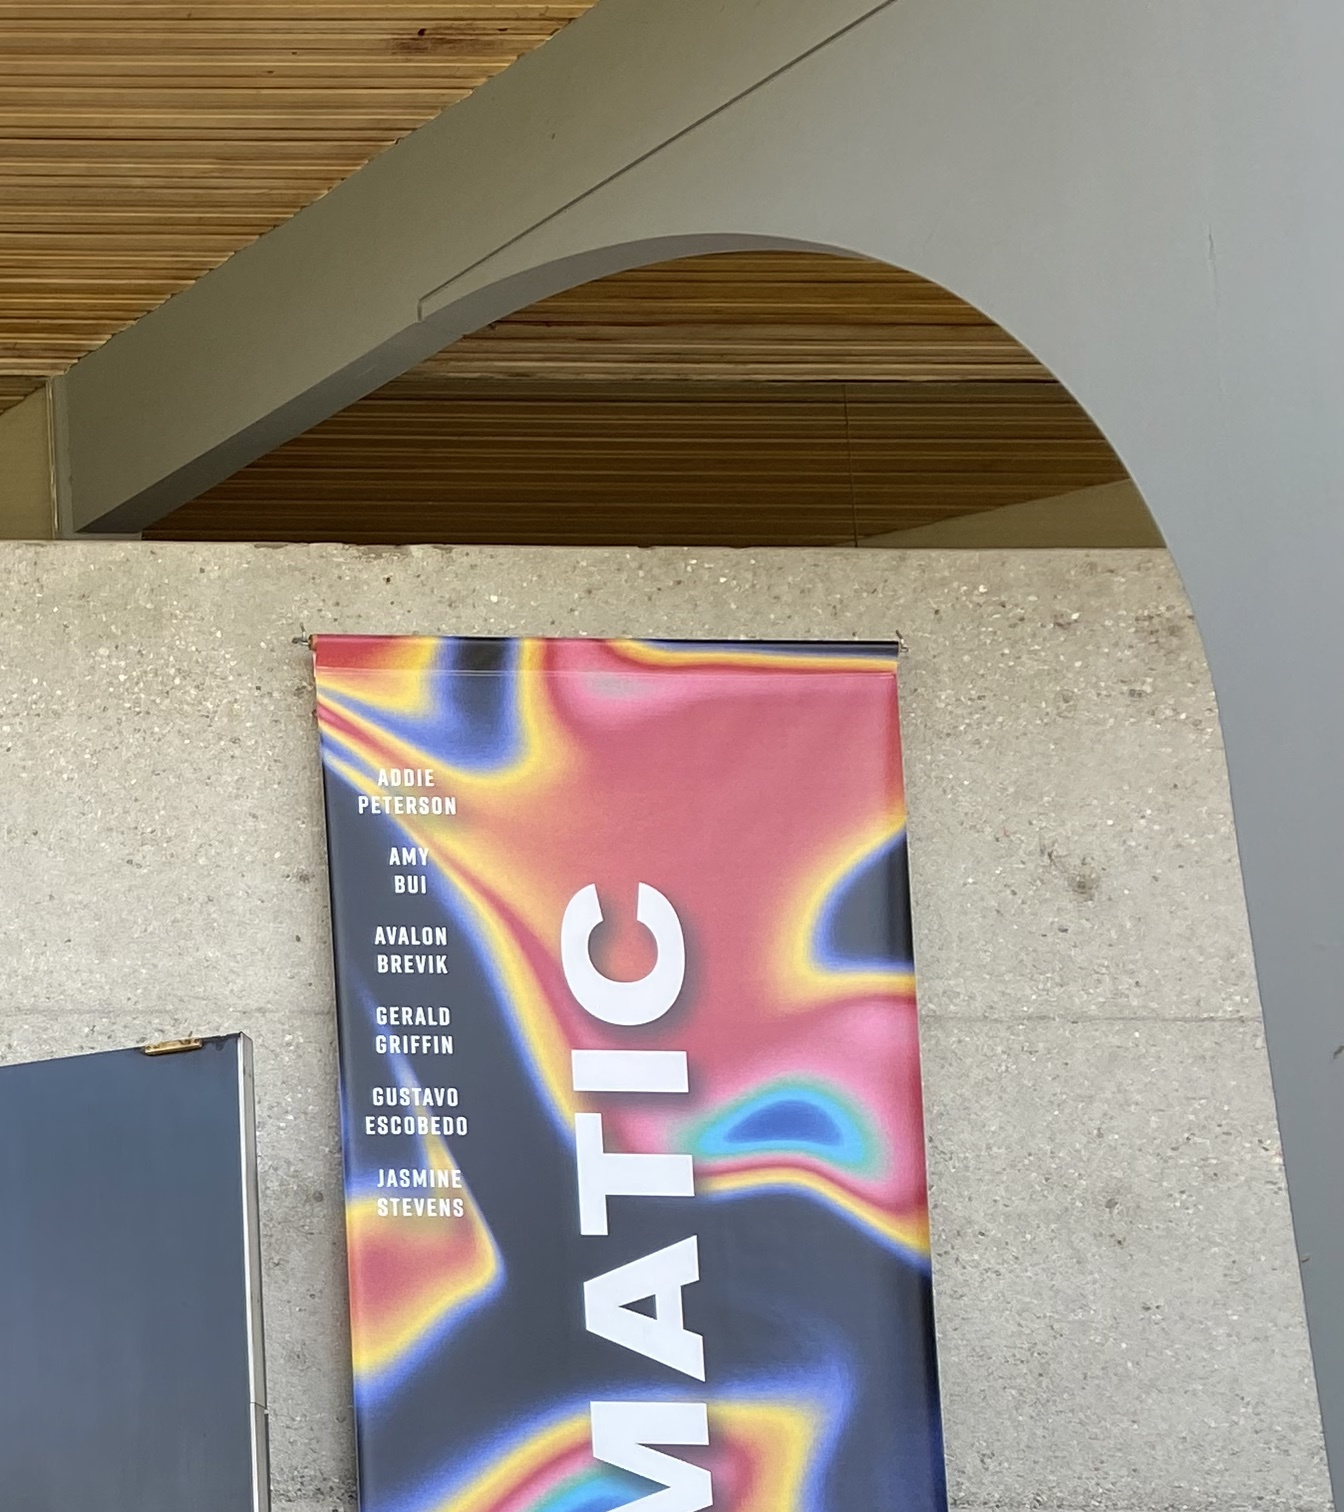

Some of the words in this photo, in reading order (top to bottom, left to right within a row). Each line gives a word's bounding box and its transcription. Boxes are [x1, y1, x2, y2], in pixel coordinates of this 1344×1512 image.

[378, 769, 435, 786] ADDIE
[358, 797, 456, 815] PETERSON
[389, 848, 429, 866] AMY
[394, 876, 426, 894] BUI
[375, 927, 447, 945] AVALON
[377, 955, 448, 974] BREVIK
[376, 1007, 450, 1026] GERALD
[375, 1035, 453, 1054] GRIFFIN
[372, 1087, 459, 1107] GUSTAVO
[366, 1116, 467, 1135] ESCOBEDO
[377, 1169, 461, 1189] JASMINE
[377, 1198, 464, 1217] STEVENS
